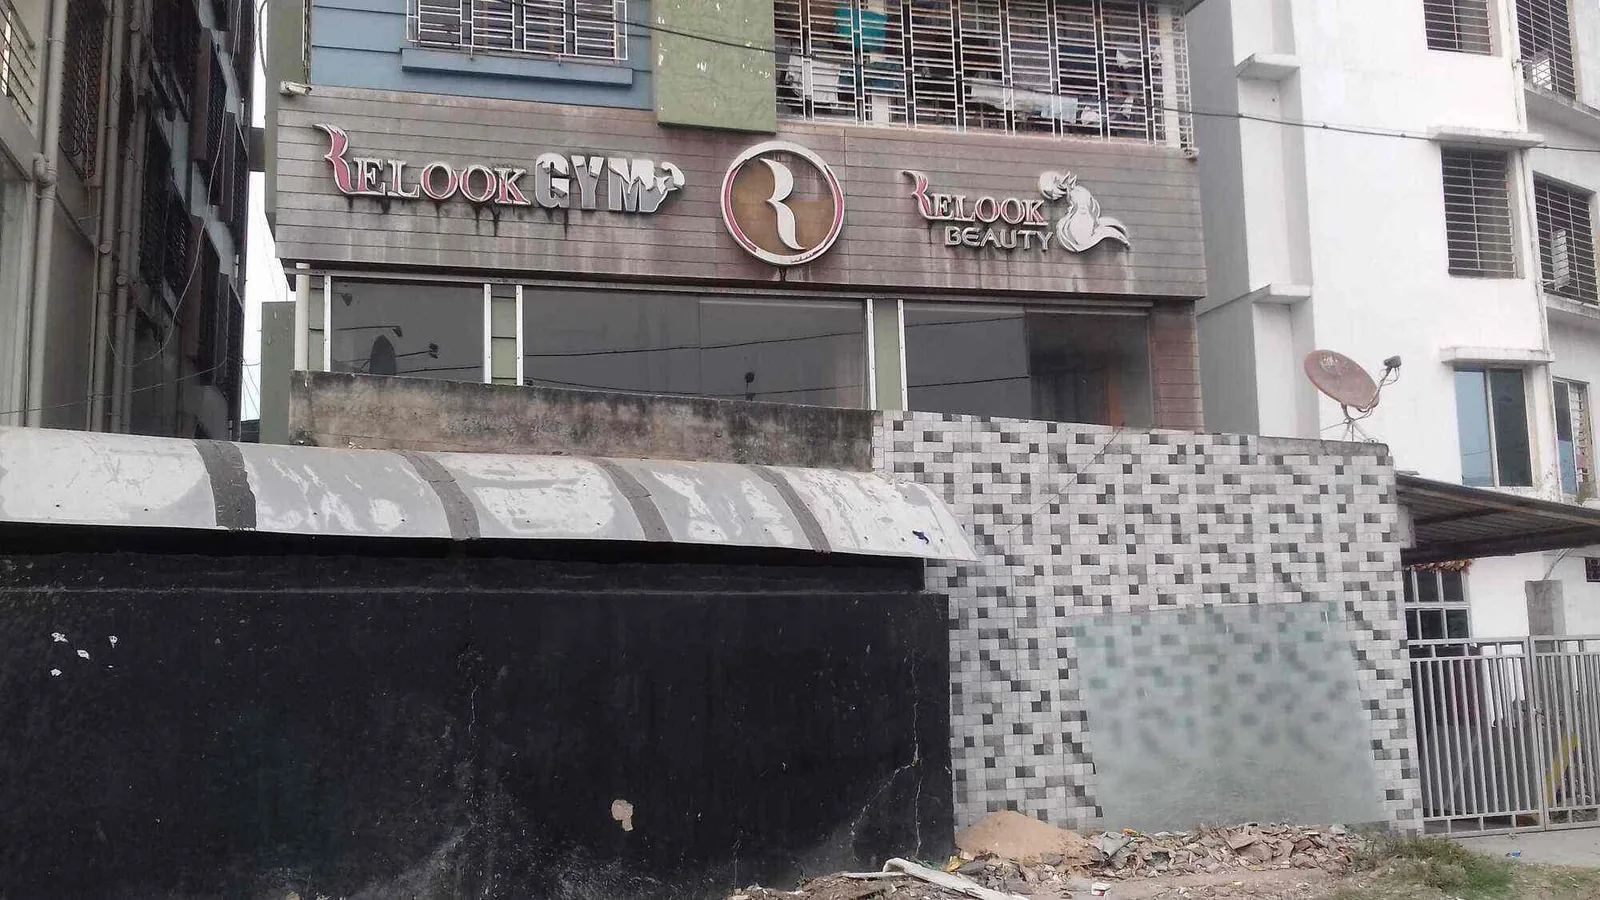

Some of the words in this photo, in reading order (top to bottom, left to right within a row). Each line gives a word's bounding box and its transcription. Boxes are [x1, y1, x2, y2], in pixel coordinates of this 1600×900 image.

[312, 123, 531, 206] RELOOK
[535, 152, 685, 213] GYM
[902, 169, 1049, 226] RELOOK
[944, 225, 1054, 250] BEAUTY
